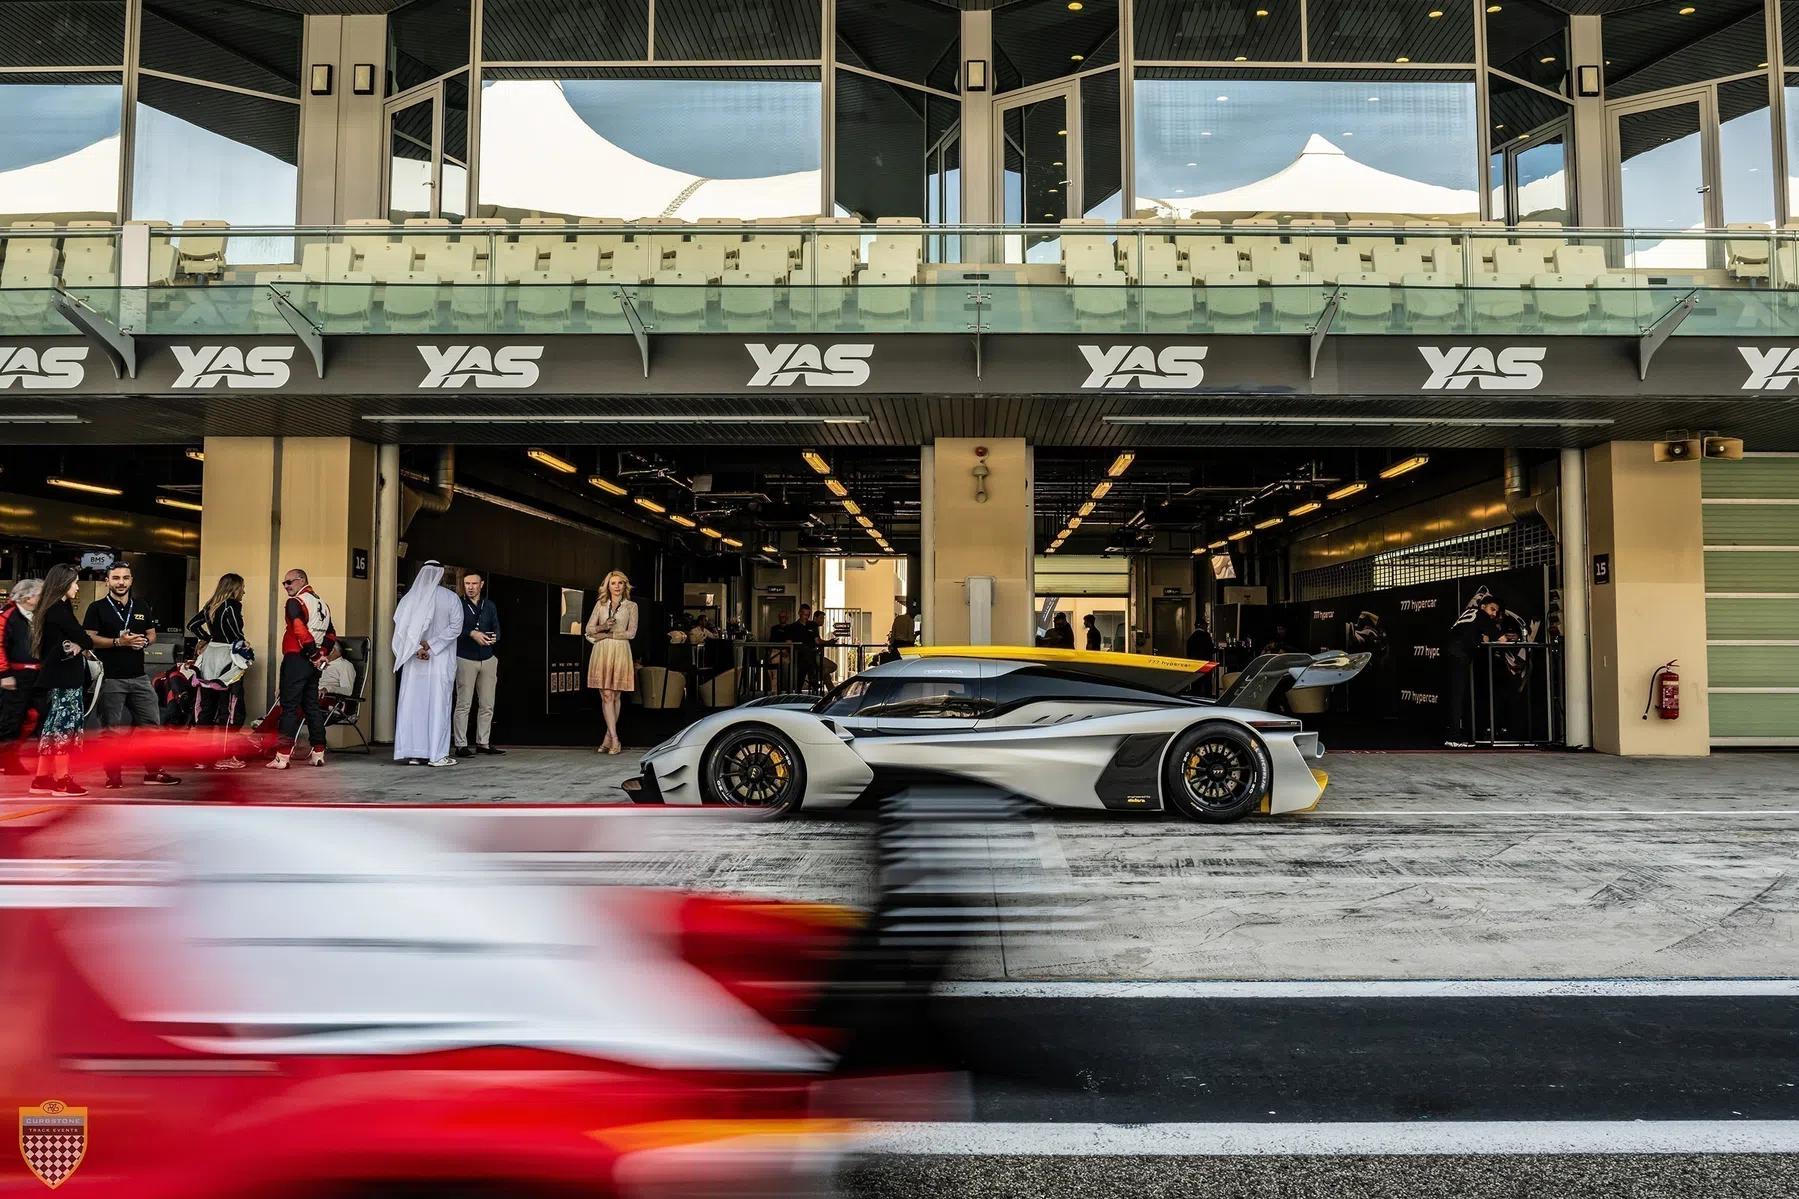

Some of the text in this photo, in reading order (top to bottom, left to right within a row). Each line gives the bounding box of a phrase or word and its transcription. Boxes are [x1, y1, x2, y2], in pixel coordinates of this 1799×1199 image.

[169, 345, 296, 389] YAS
[416, 344, 545, 388] YAS
[744, 342, 875, 388] YAS
[1078, 344, 1209, 389] YAS
[1417, 346, 1547, 390] YAS
[355, 556, 366, 570] 16
[1596, 562, 1606, 576] 15
[1411, 598, 1437, 612] hypercar
[1413, 645, 1424, 656] 777
[1401, 690, 1439, 705] 777 hypercar
